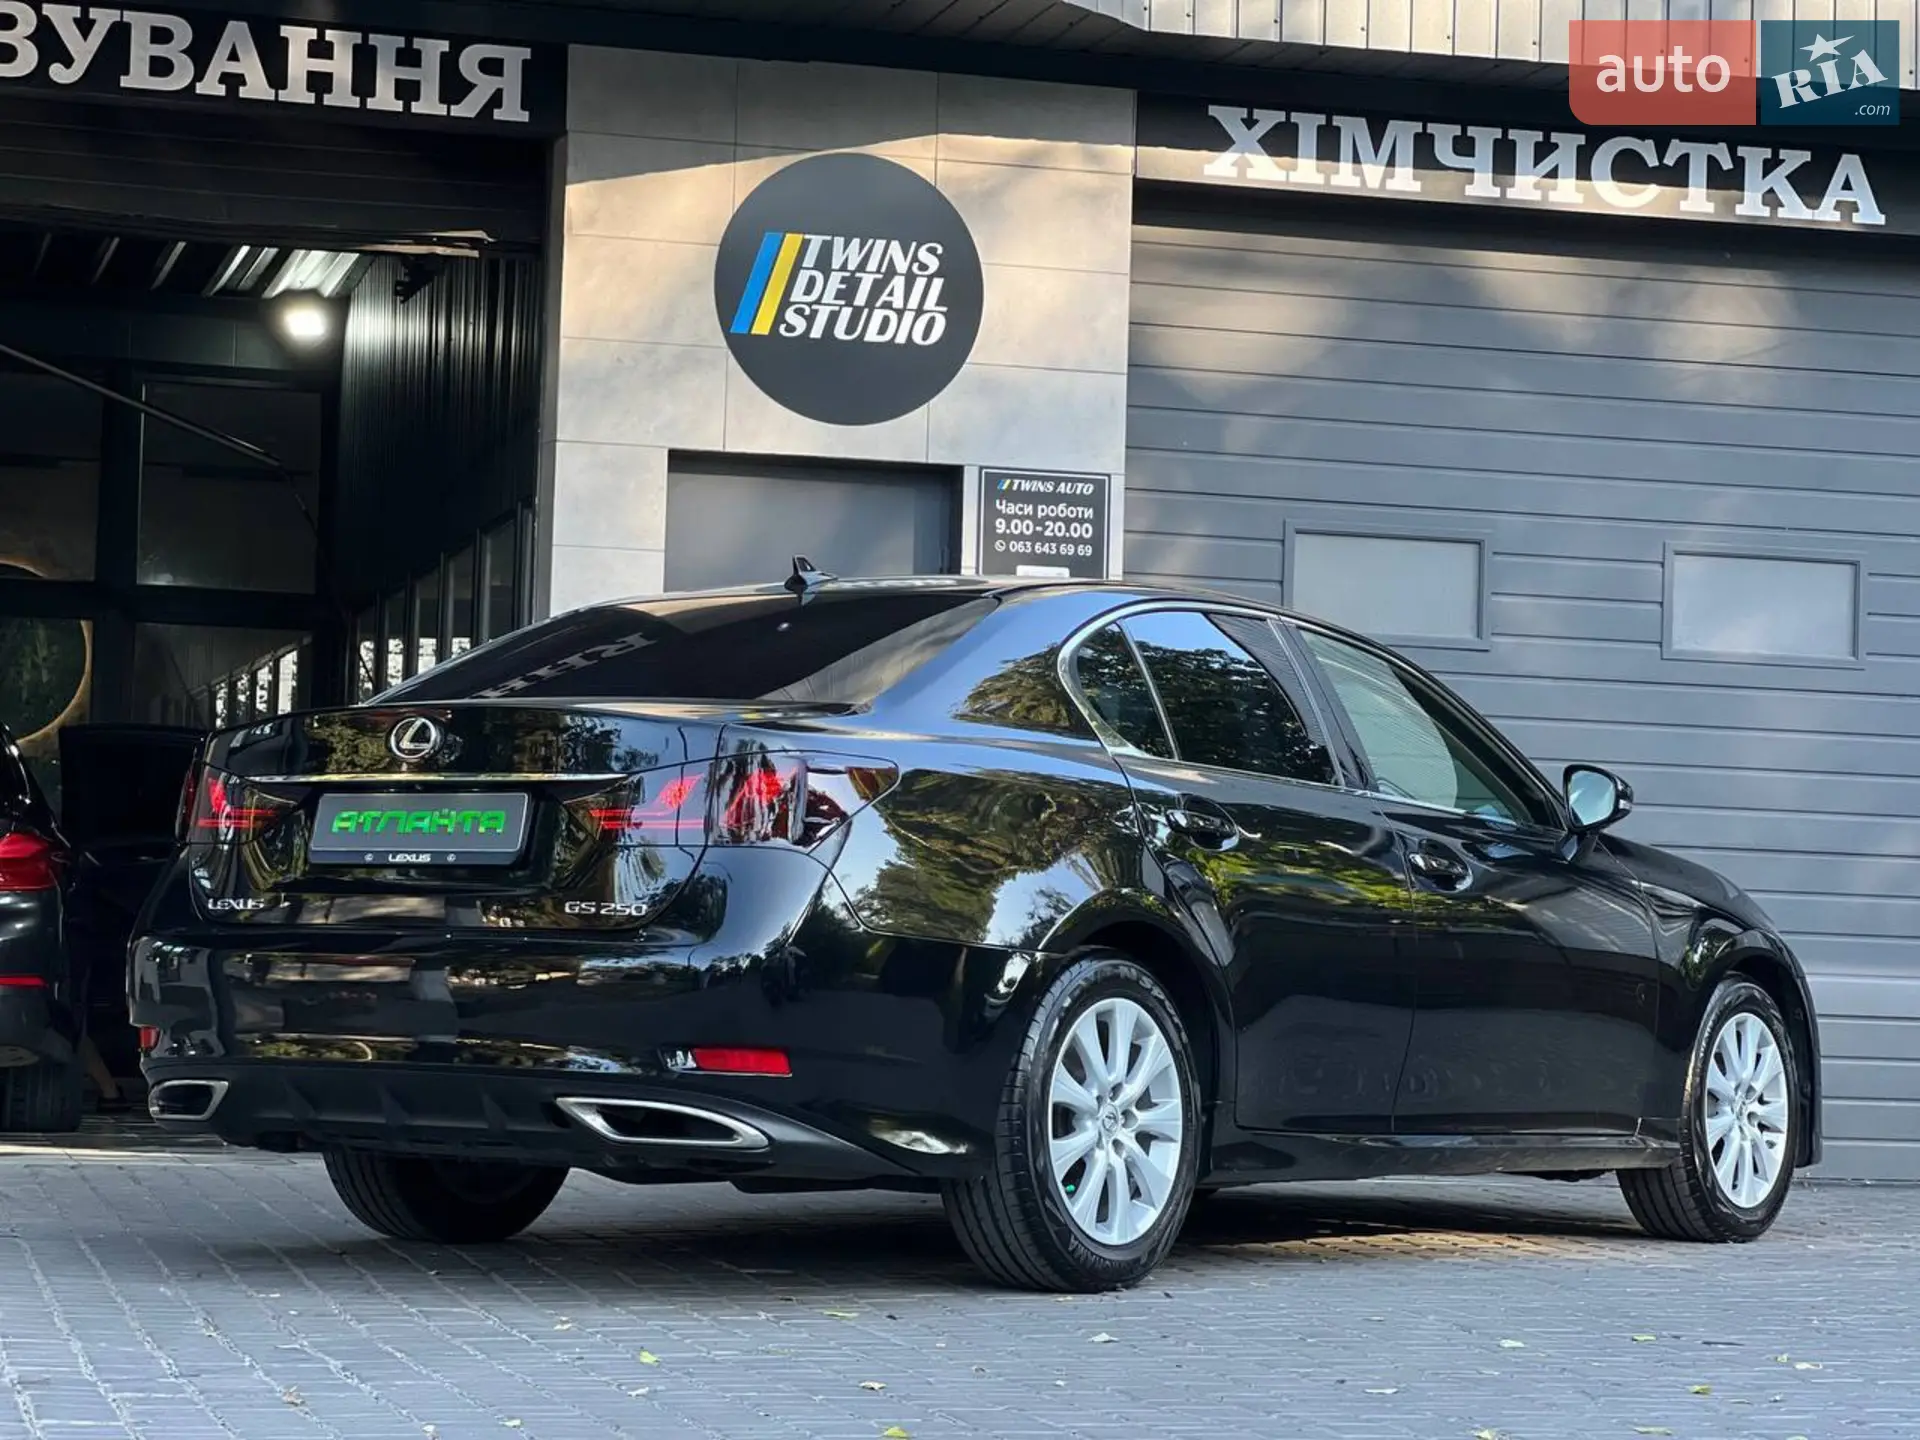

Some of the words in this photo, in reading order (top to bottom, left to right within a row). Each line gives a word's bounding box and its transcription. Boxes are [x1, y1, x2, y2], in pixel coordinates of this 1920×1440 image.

[1203, 104, 1887, 226] ХІМЧИСТКА
[801, 233, 943, 276] TWINS
[789, 269, 948, 312] DETAIL
[779, 304, 947, 346] STUDIO
[1012, 479, 1054, 492] TWINS
[1056, 482, 1094, 495] AUTO
[995, 499, 1033, 515] Часи
[1037, 503, 1093, 519] роботи
[1009, 541, 1032, 553] 063
[1034, 542, 1057, 555] 643
[1059, 544, 1075, 556] 69
[1077, 545, 1093, 556] 69
[388, 853, 431, 862] LEXUS
[207, 898, 264, 909] LEXUS
[564, 901, 596, 914] GS
[600, 902, 648, 916] 250
